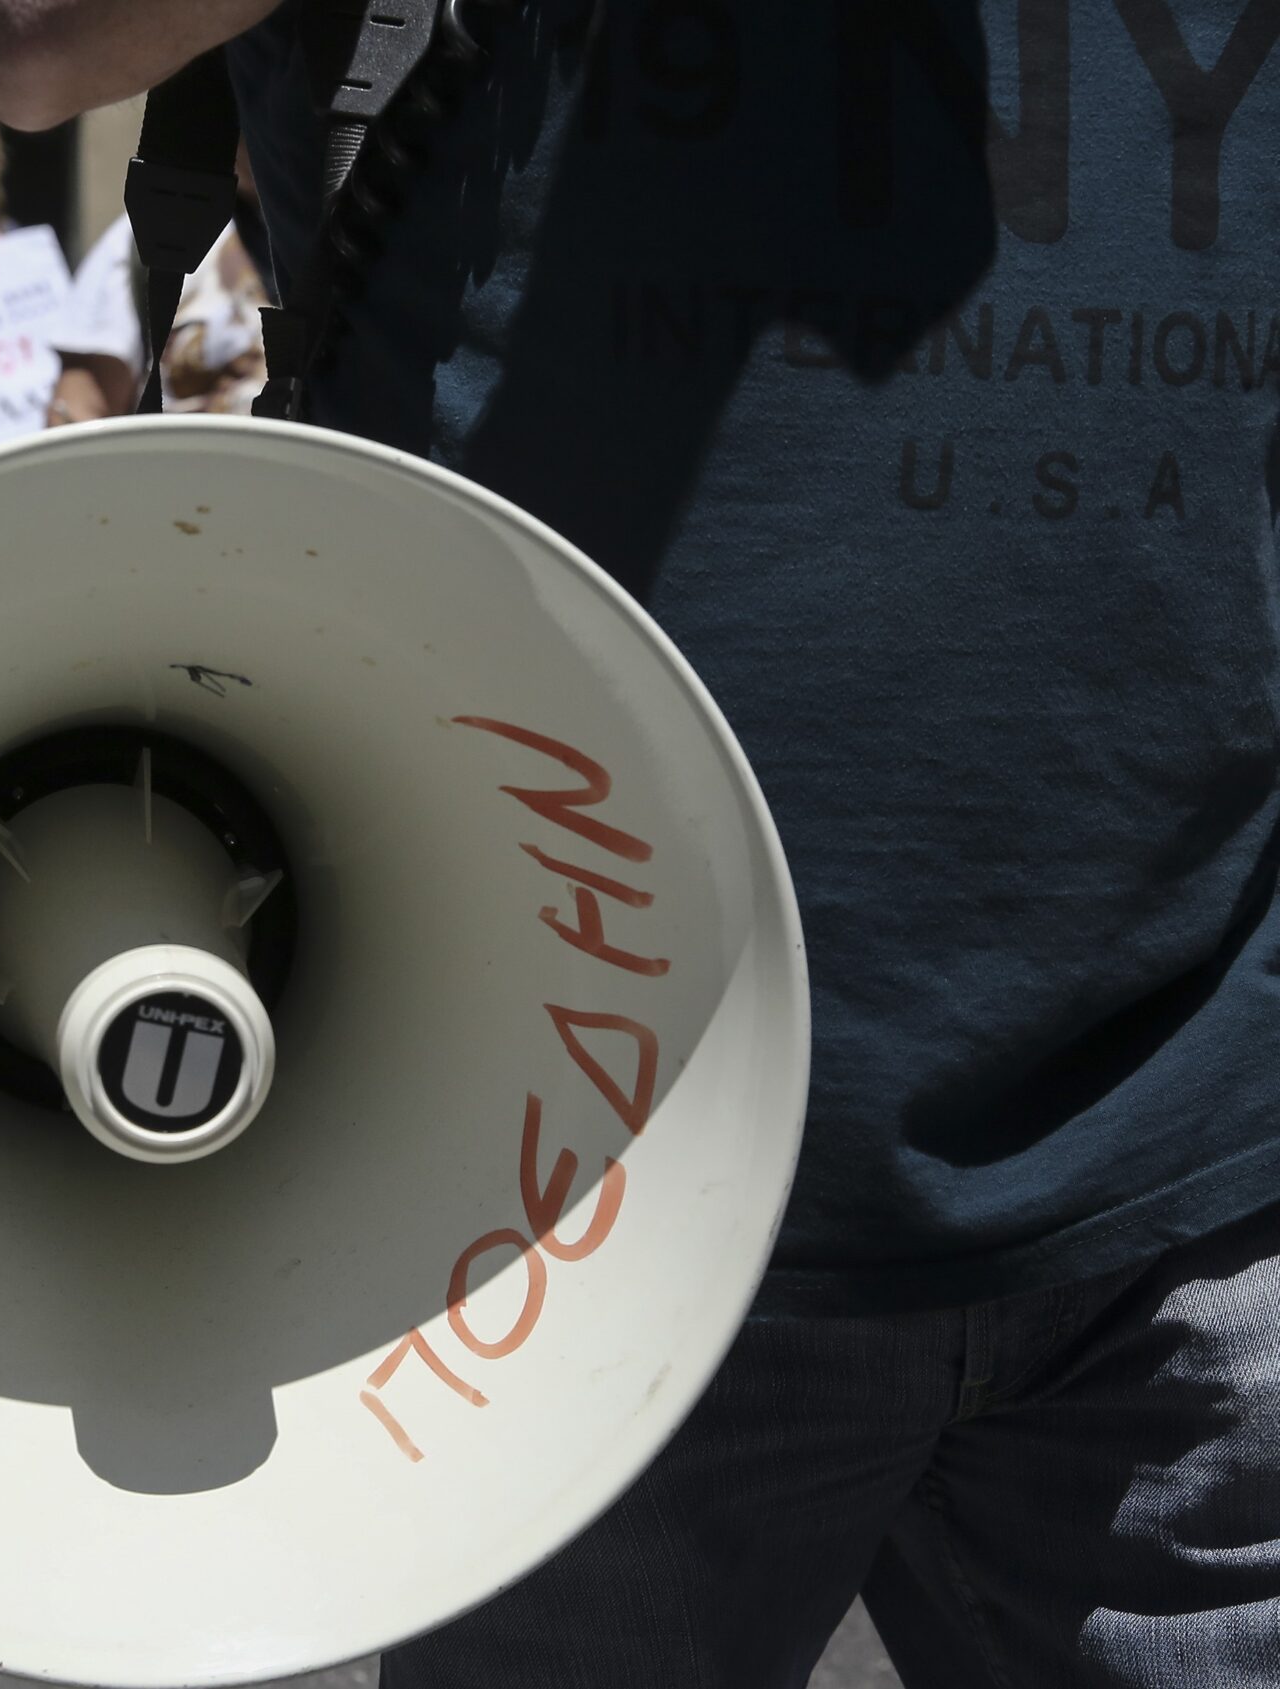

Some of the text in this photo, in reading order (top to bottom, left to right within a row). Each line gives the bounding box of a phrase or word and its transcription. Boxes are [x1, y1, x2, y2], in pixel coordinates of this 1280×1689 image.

[834, 0, 1280, 250] NY
[137, 1004, 226, 1033] UNI-PEX
[360, 715, 671, 1462] ΠΟΕΔΗΝ
